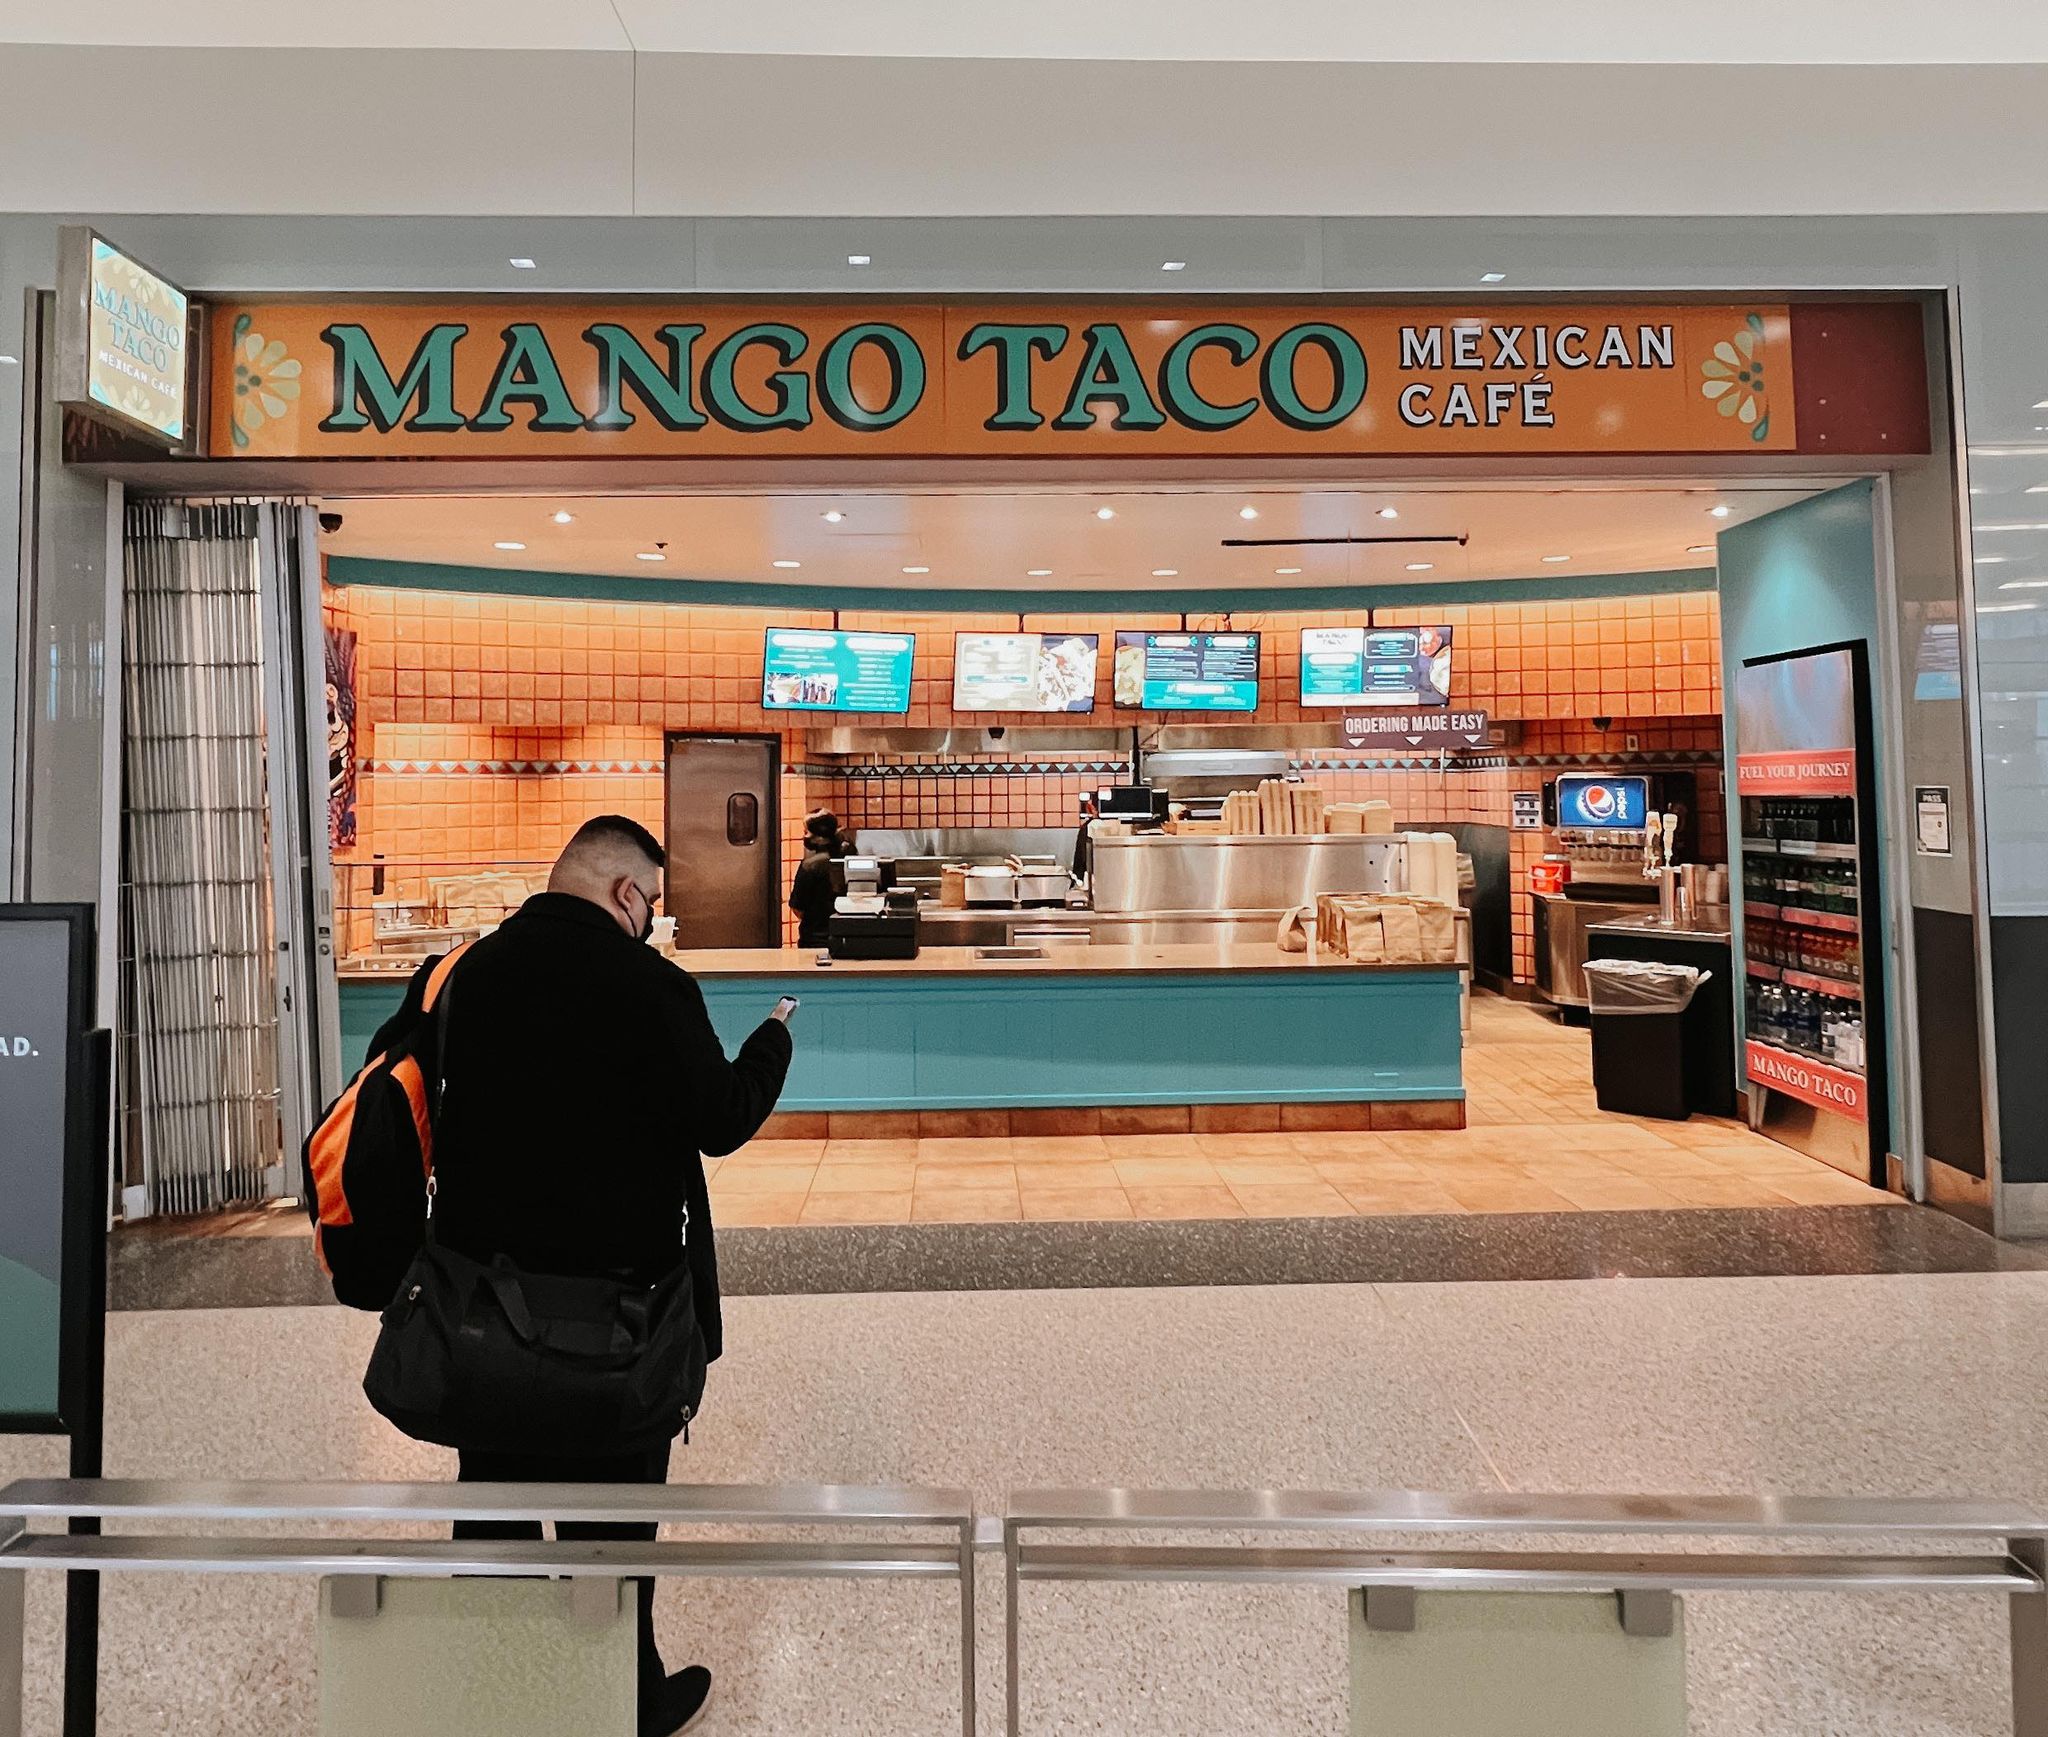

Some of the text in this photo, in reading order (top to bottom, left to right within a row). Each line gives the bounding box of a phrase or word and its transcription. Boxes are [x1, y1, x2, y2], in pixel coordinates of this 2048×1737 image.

[94, 279, 180, 351] MANGO
[108, 318, 168, 373] TACO
[1400, 325, 1675, 369] MEXICAN
[98, 350, 178, 400] MEXICAN CAFÉ
[318, 322, 1369, 434] MANGO TACO
[1399, 372, 1555, 428] CAFÉ
[1345, 713, 1485, 734] ORDERING MADE EASY
[1739, 762, 1851, 780] FUEL YOUR JOURNEY
[1615, 787, 1628, 820] pepsi
[1753, 1054, 1857, 1106] MANGO TACO
